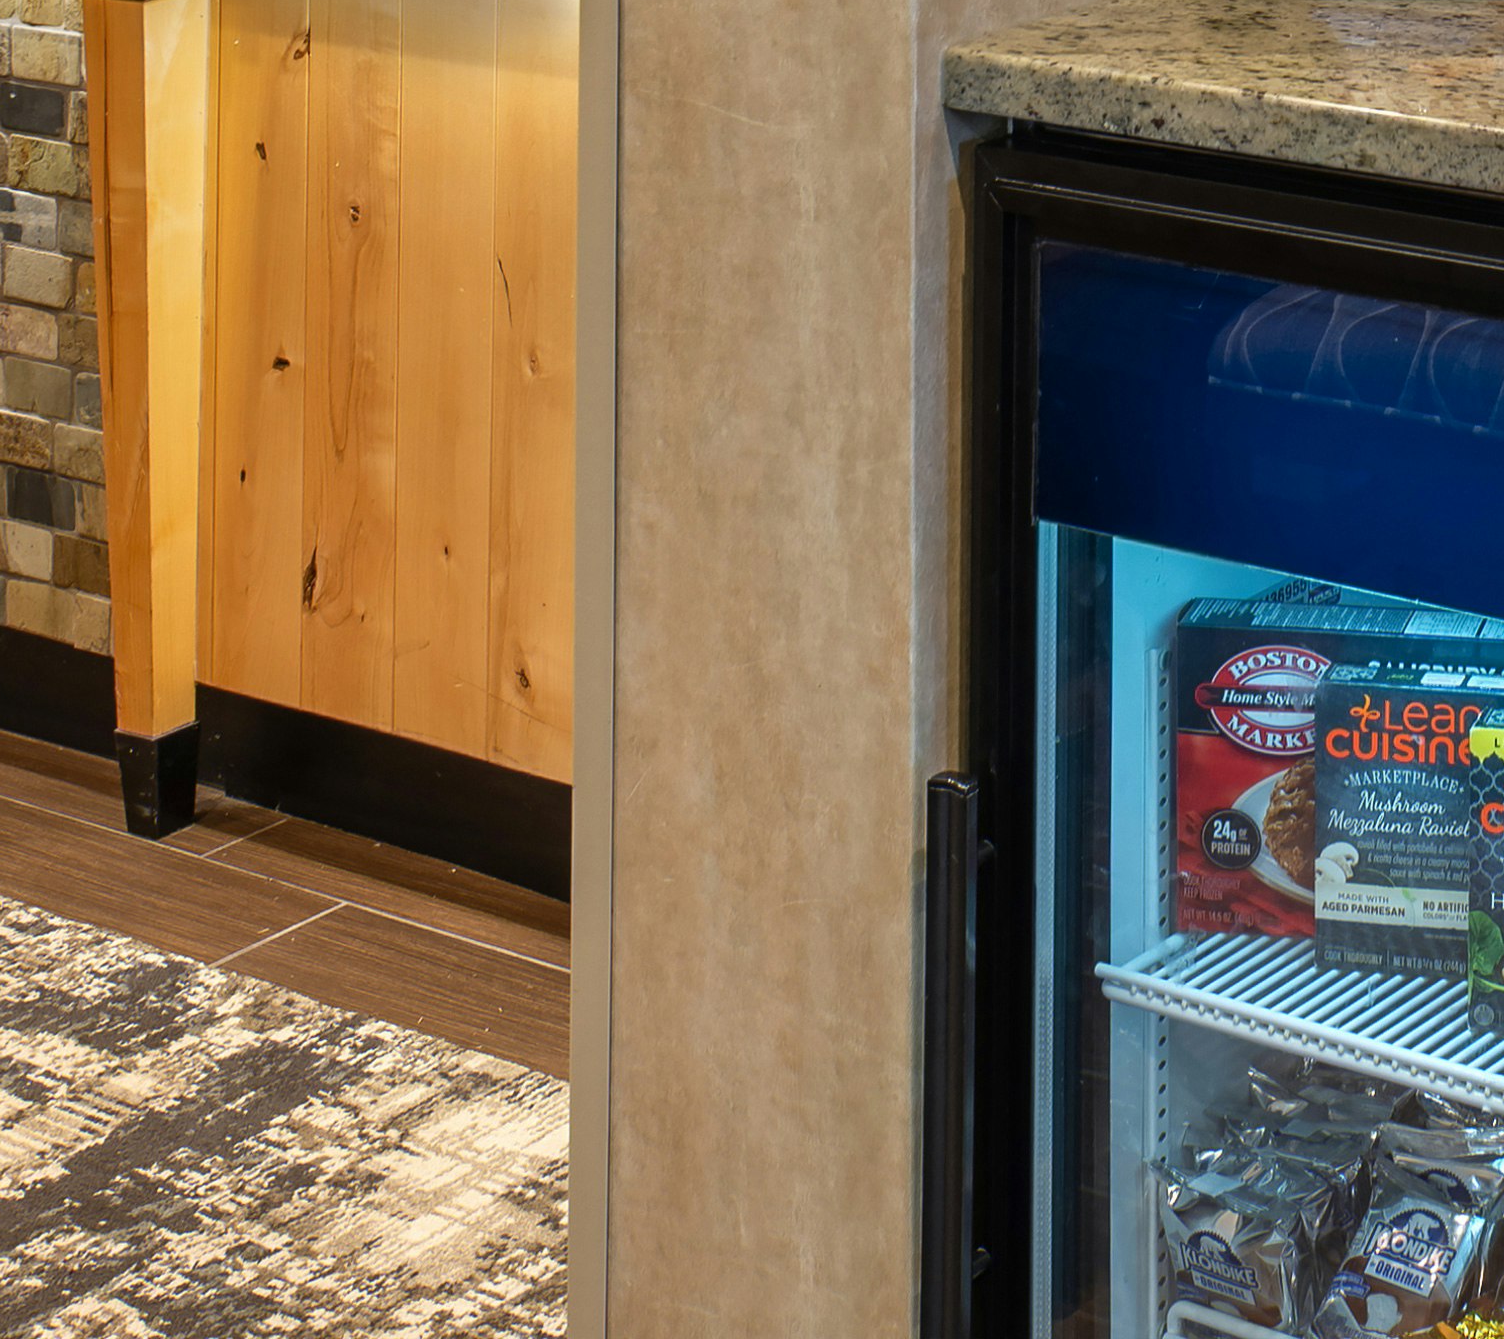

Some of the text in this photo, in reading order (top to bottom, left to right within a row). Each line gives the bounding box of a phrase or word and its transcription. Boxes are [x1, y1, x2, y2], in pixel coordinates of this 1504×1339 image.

[1221, 689, 1295, 707] Home Style
[1347, 768, 1459, 794] MARKETPLACE
[1357, 790, 1447, 815] Mushroom
[1326, 809, 1415, 838] Mezzaluna
[1210, 841, 1252, 857] PROTEIN
[1337, 892, 1390, 905] MADE WITH
[1422, 900, 1436, 913] NO
[1321, 901, 1407, 918] AGED PARMESAN
[1374, 1264, 1426, 1290] ORIGINAL
